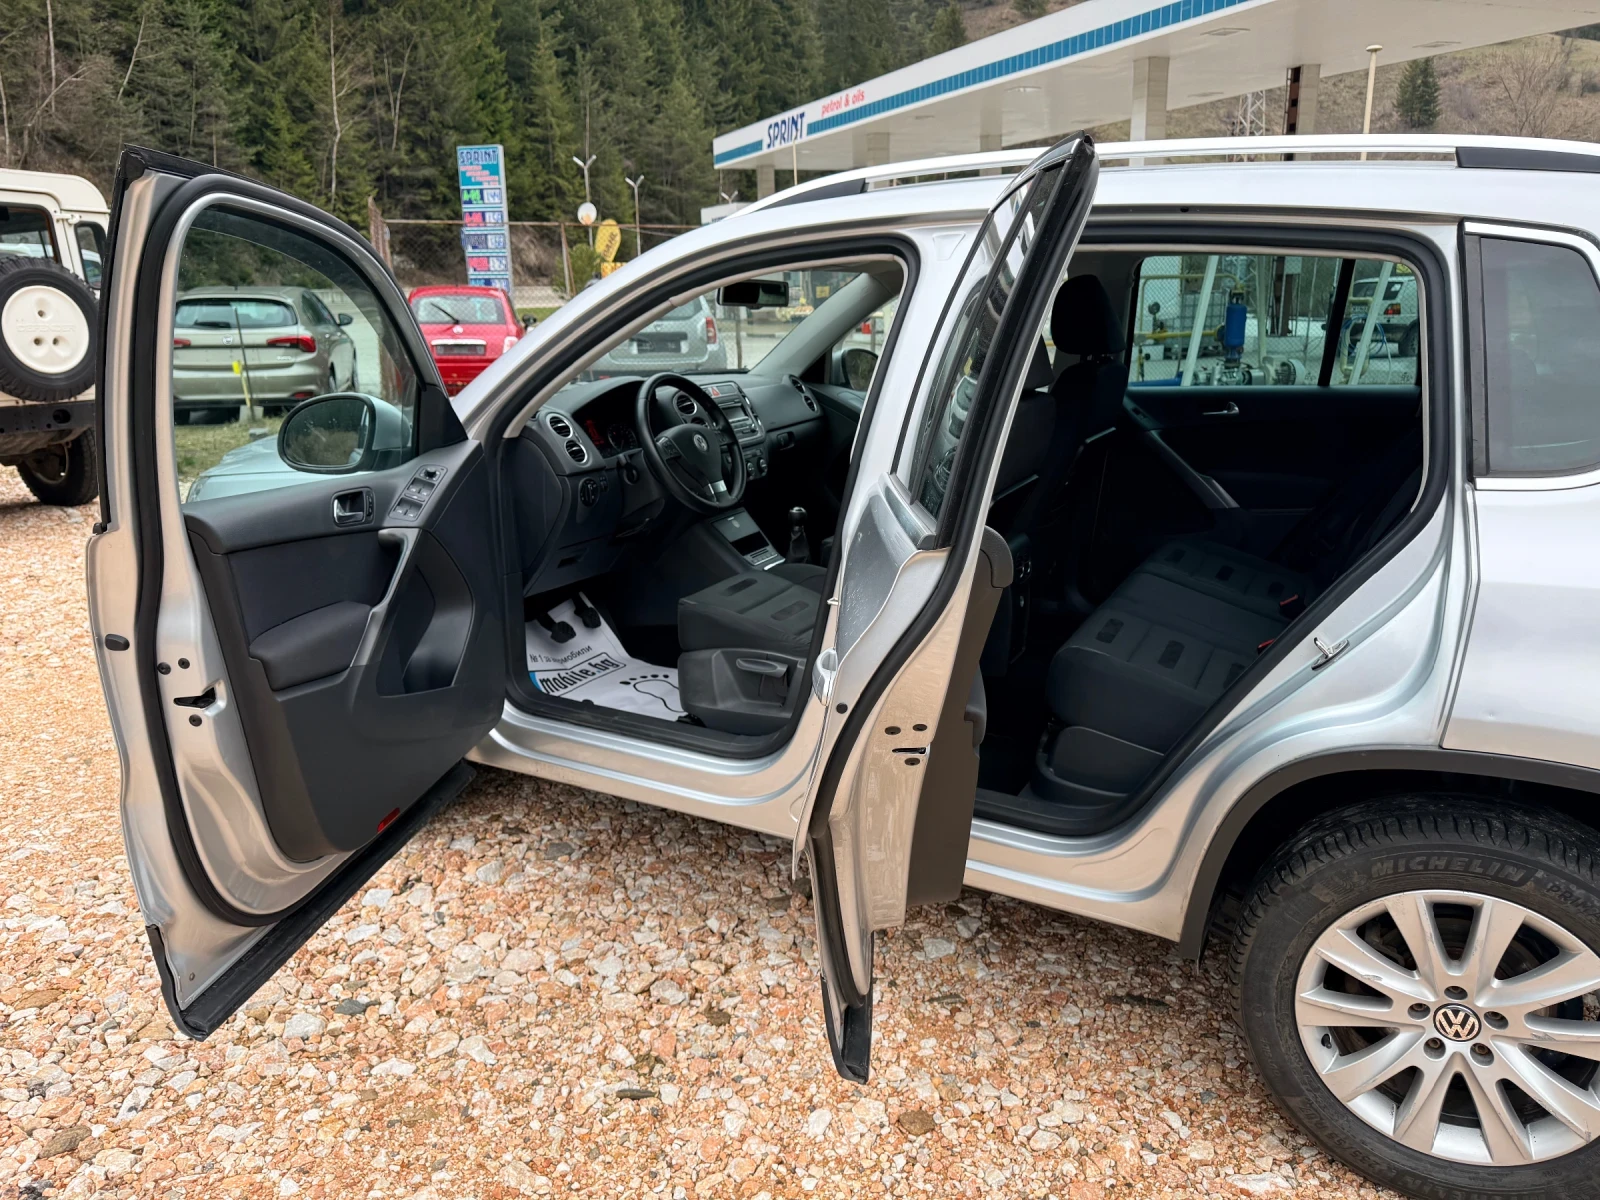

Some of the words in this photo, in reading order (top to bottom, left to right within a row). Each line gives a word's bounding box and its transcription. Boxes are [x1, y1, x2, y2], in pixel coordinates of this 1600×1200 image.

[821, 97, 842, 117] petrol
[844, 94, 850, 107] &
[852, 89, 865, 104] oils
[767, 112, 805, 149] SPRINT
[459, 150, 497, 164] SPRINT
[539, 658, 620, 694] mobile.bg
[1371, 855, 1526, 882] MICHELIN
